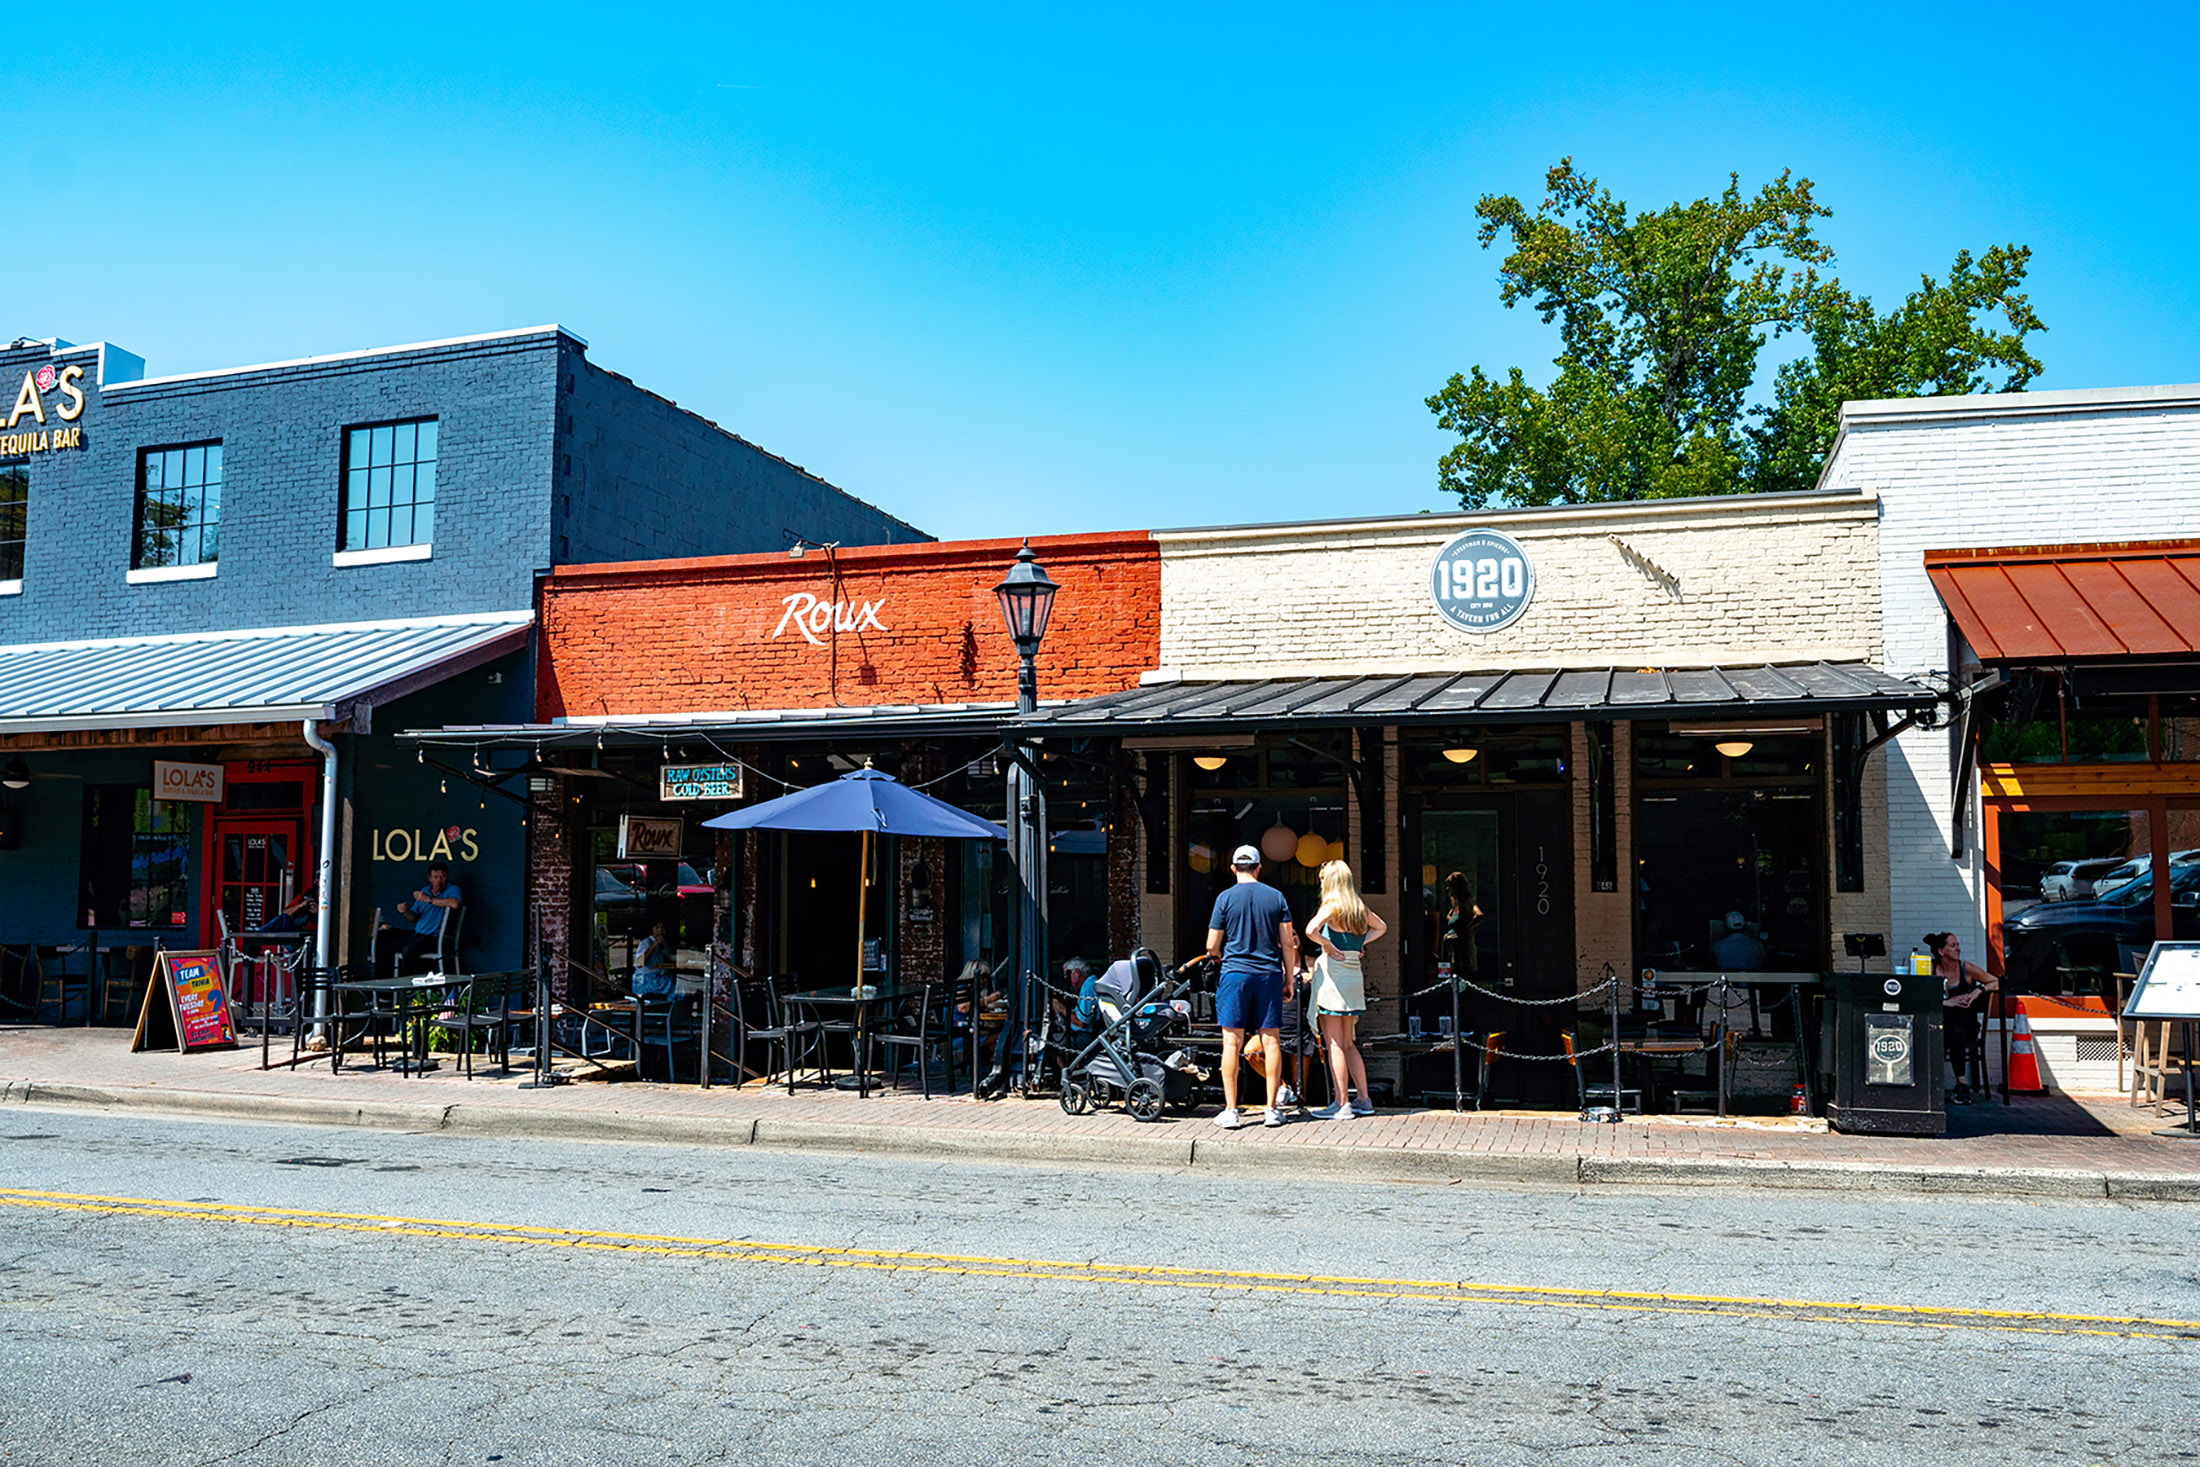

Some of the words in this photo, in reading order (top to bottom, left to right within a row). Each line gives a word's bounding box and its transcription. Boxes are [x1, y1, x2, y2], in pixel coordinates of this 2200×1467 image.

[0, 365, 84, 427] A'S
[0, 431, 49, 455] EQUILA
[53, 427, 81, 449] BAR
[1438, 557, 1523, 600] 1920
[772, 593, 889, 646] Roux
[1457, 608, 1483, 623] TAVERN
[1485, 612, 1500, 623] FOR
[1501, 603, 1514, 617] ALL
[163, 768, 215, 788] LOLA'S
[667, 768, 691, 782] RAW
[692, 766, 737, 781] OYSTERS
[673, 783, 700, 796] COLD
[704, 782, 730, 796] BEER
[373, 828, 479, 862] LOLA'S
[631, 822, 673, 852] Roux
[1536, 846, 1550, 915] 1920
[180, 967, 200, 980] TEAM
[191, 978, 210, 988] TRIVIA
[180, 999, 204, 1011] TUESDAY
[181, 993, 198, 1003] EVERY
[1876, 1041, 1903, 1052] 1920
